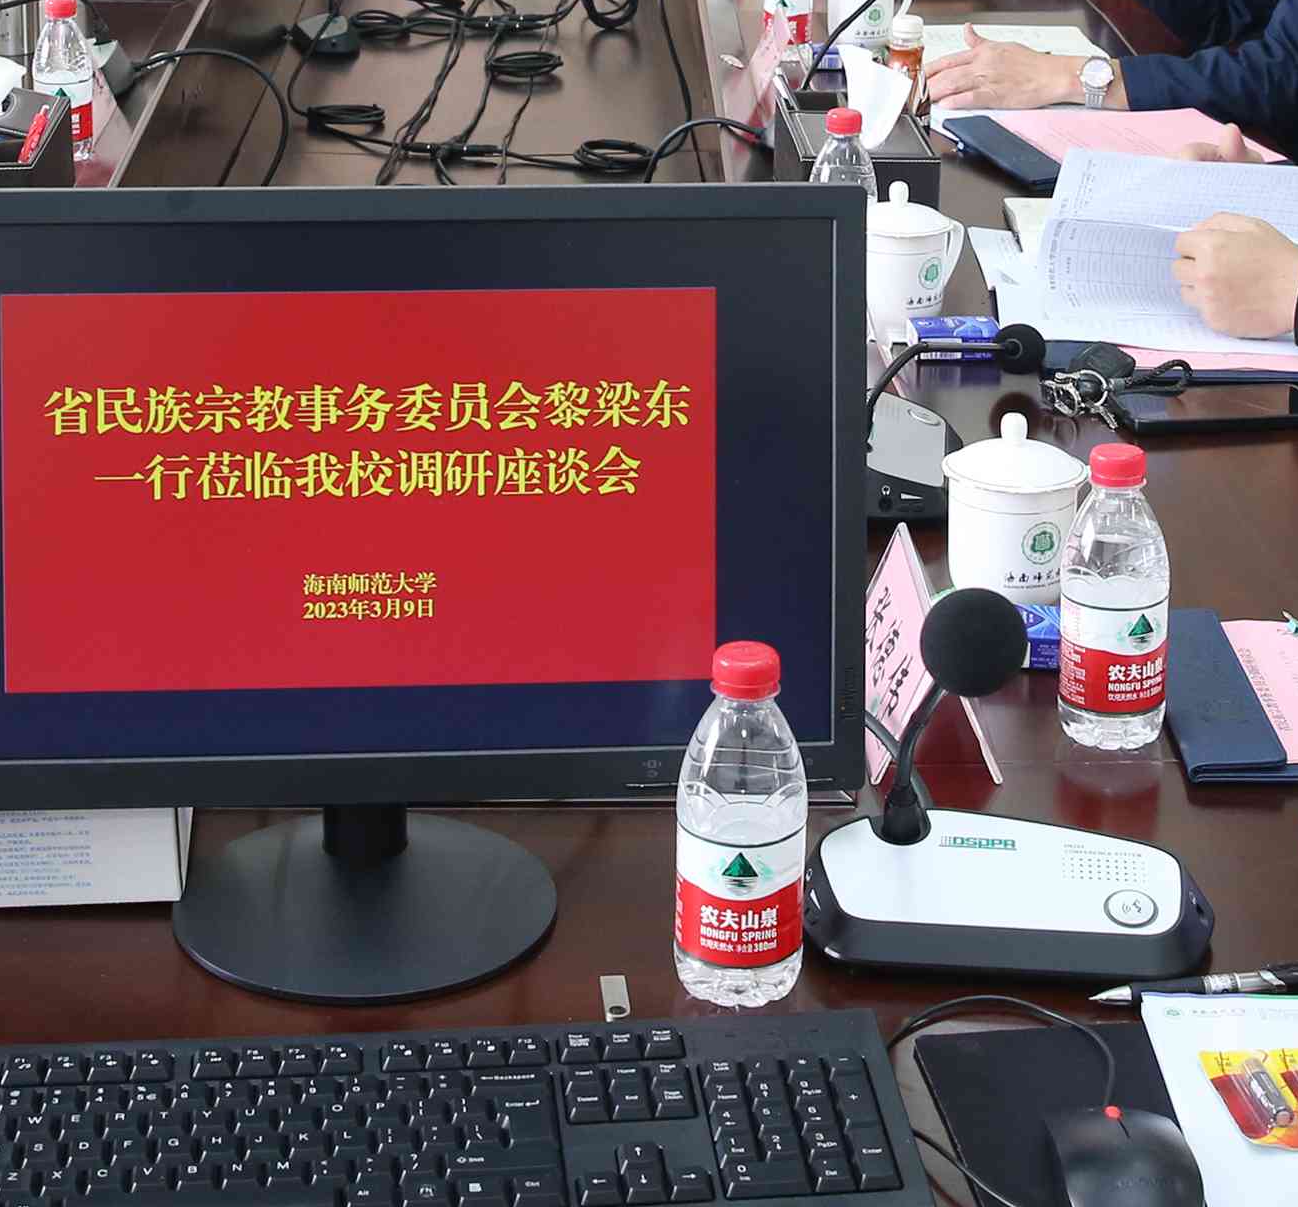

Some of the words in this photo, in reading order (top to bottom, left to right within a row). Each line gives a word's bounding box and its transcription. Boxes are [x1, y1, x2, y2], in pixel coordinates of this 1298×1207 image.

[43, 380, 691, 437] 省民族宗教事务委员会黎梁东
[95, 446, 641, 501] 一行莅临我校调研座谈会
[303, 572, 437, 596] 海南师范大学
[303, 598, 435, 620] 2023年3月9日
[700, 904, 778, 930] 农夫山泉
[741, 928, 778, 942] SPRING
[287, 1107, 292, 1115] I
[332, 1104, 344, 1112] O
[71, 1114, 82, 1123] E
[115, 1112, 126, 1121] R
[160, 1111, 169, 1119] T
[202, 1110, 212, 1118] Y
[28, 1116, 43, 1124] W
[255, 1135, 263, 1143] J
[299, 1133, 309, 1141] K
[343, 1131, 352, 1139] L
[123, 1140, 133, 1148] F
[168, 1138, 179, 1146] G
[211, 1136, 222, 1144] H
[33, 1143, 44, 1151] S
[79, 1142, 89, 1150] D
[187, 1165, 198, 1174] B
[232, 1163, 243, 1172] N
[276, 1161, 290, 1170] M
[52, 1171, 62, 1180] X
[97, 1169, 108, 1178] C
[143, 1167, 153, 1176] V
[7, 1172, 19, 1181] Z
